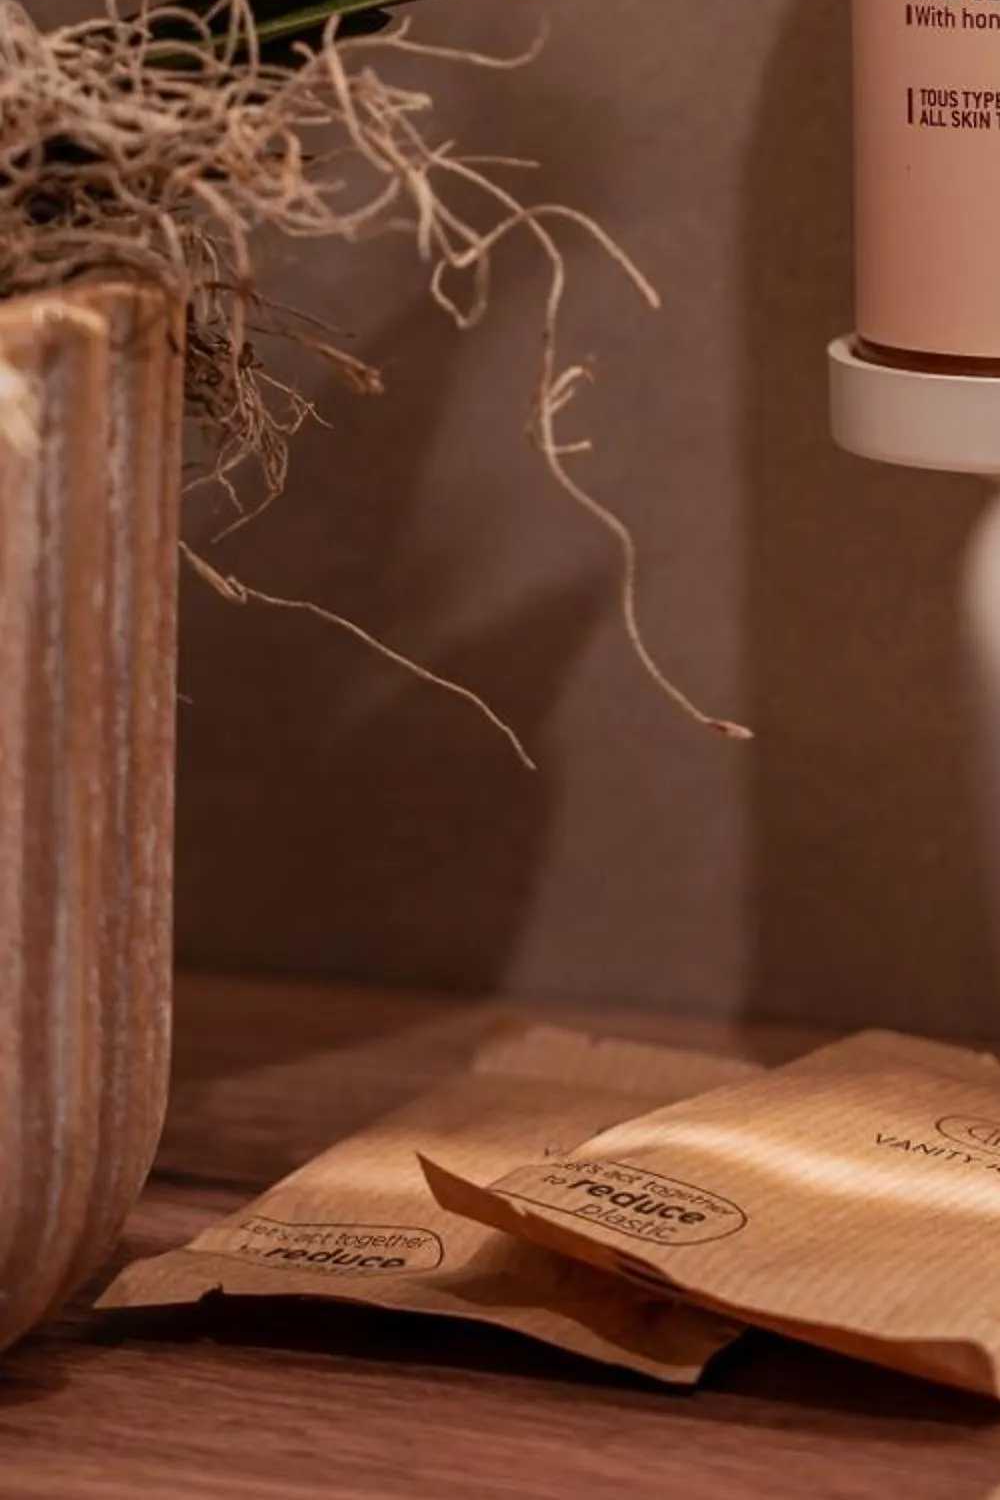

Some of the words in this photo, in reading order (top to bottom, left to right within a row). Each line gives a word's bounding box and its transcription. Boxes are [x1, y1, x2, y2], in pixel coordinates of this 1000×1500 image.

[914, 5, 955, 28] With
[919, 88, 959, 108] TOUS
[919, 110, 947, 127] ALL
[951, 110, 991, 129] SKIN
[875, 1132, 983, 1163] VANITY
[567, 1178, 706, 1225] reduce
[642, 1179, 738, 1216] together
[572, 1202, 680, 1239] plastic
[335, 1231, 436, 1250] together
[262, 1248, 407, 1269] reduce
